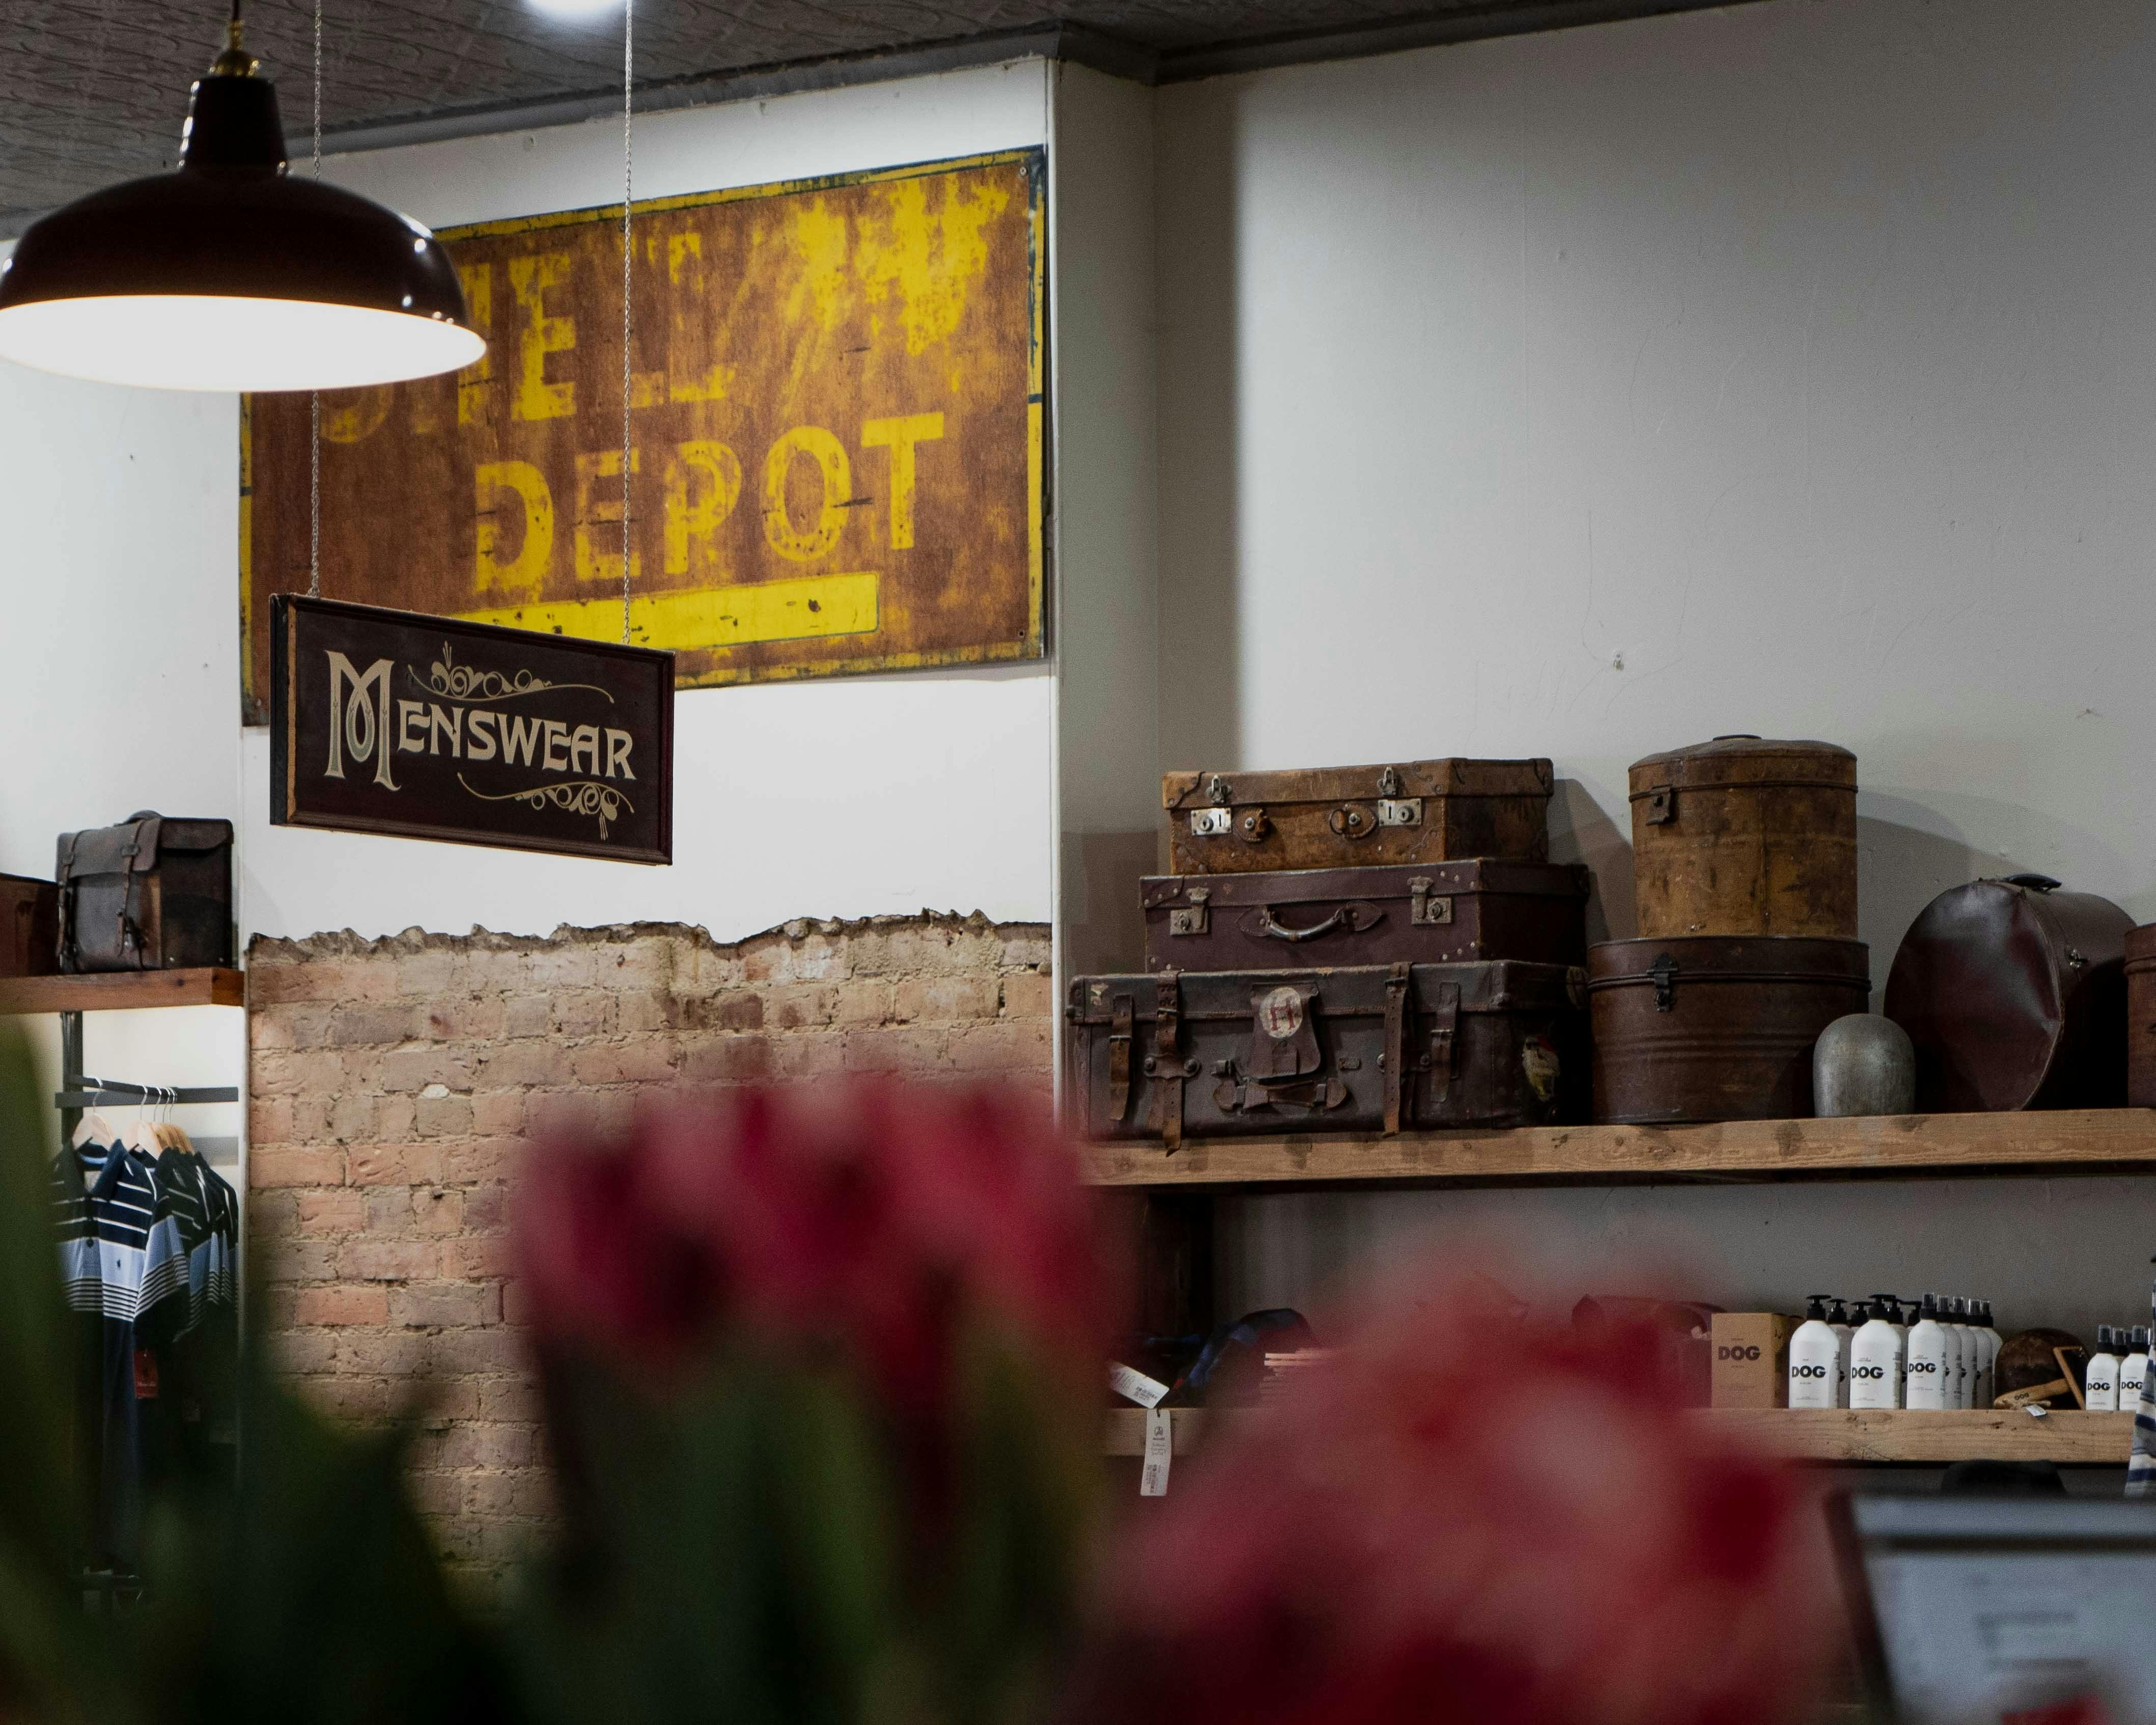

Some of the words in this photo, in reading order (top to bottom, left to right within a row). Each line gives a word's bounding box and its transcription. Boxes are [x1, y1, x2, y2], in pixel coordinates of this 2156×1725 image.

[474, 410, 945, 594] DEPOT
[1718, 1346, 1761, 1361] DOG
[1791, 1365, 1826, 1378] DOG
[1852, 1366, 1884, 1379] DOG
[1909, 1362, 1937, 1373] DOG
[2088, 1382, 2111, 1390] DOG
[2121, 1381, 2143, 1390] DOG
[2014, 1393, 2029, 1401] DOG
